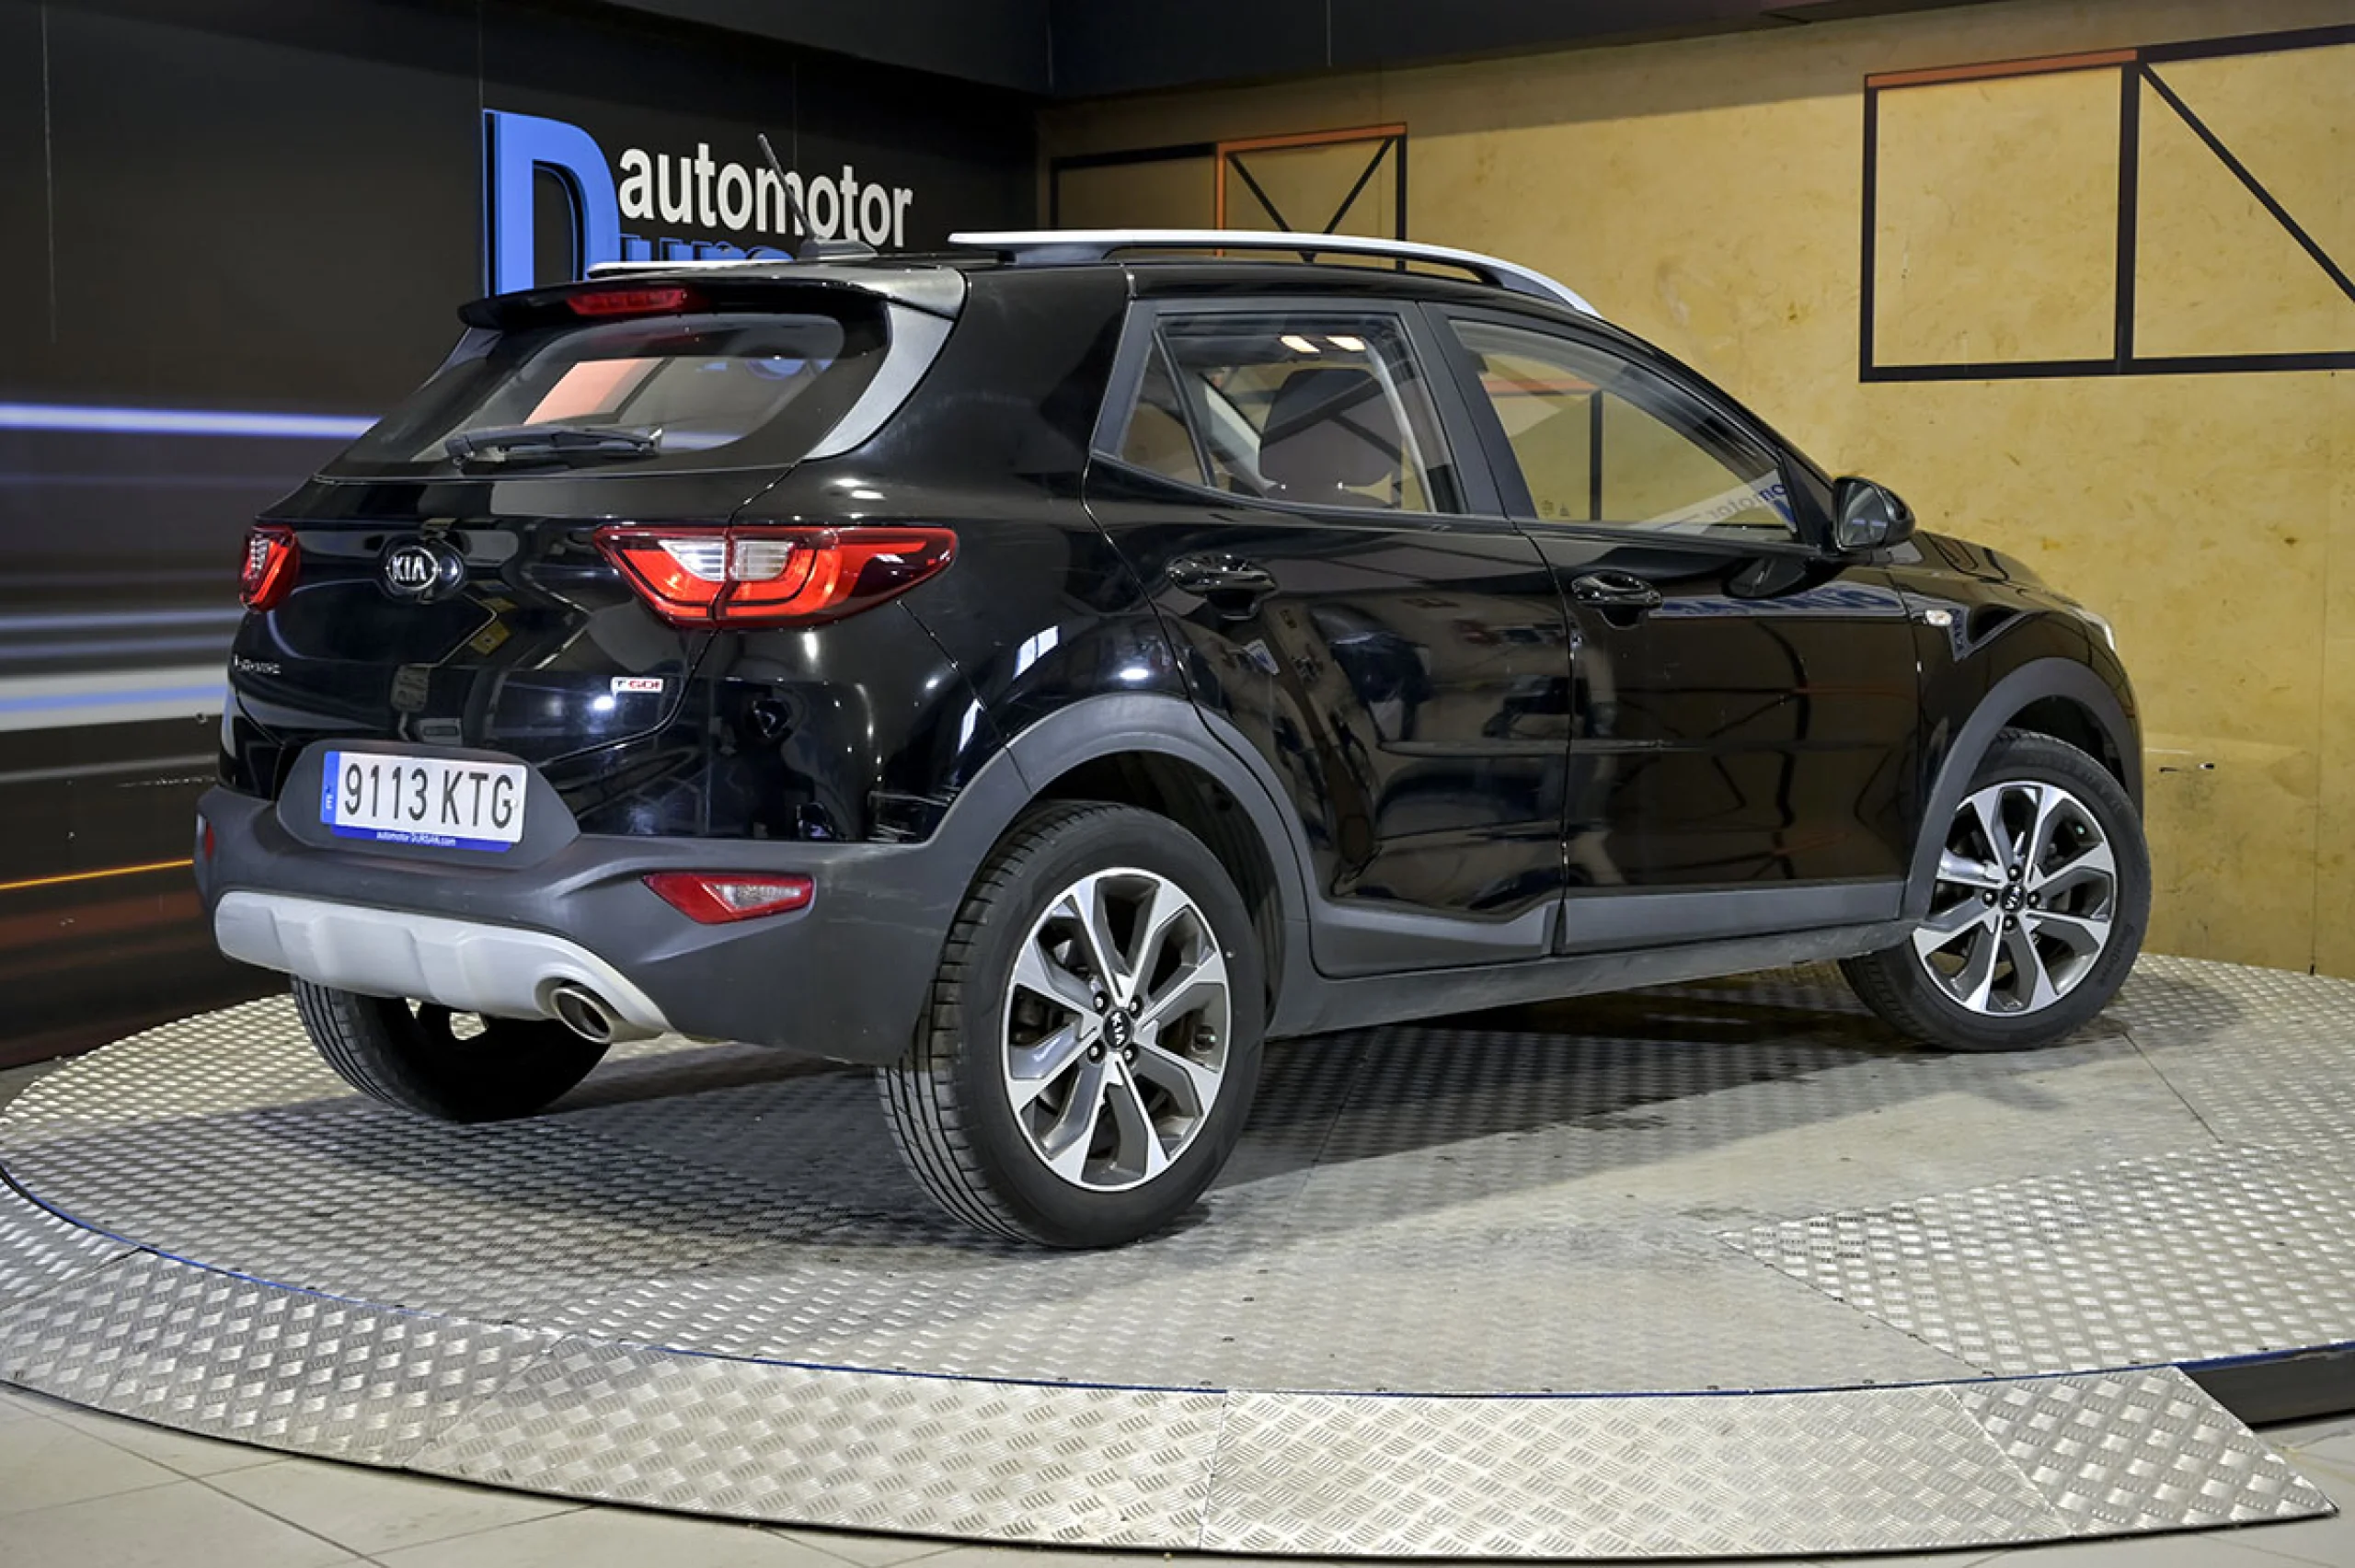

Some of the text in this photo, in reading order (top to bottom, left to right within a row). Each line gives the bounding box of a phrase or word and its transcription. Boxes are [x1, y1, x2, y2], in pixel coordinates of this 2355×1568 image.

[618, 142, 914, 248] automotor
[392, 555, 427, 582] KIA
[344, 763, 514, 829] 9113 KTG
